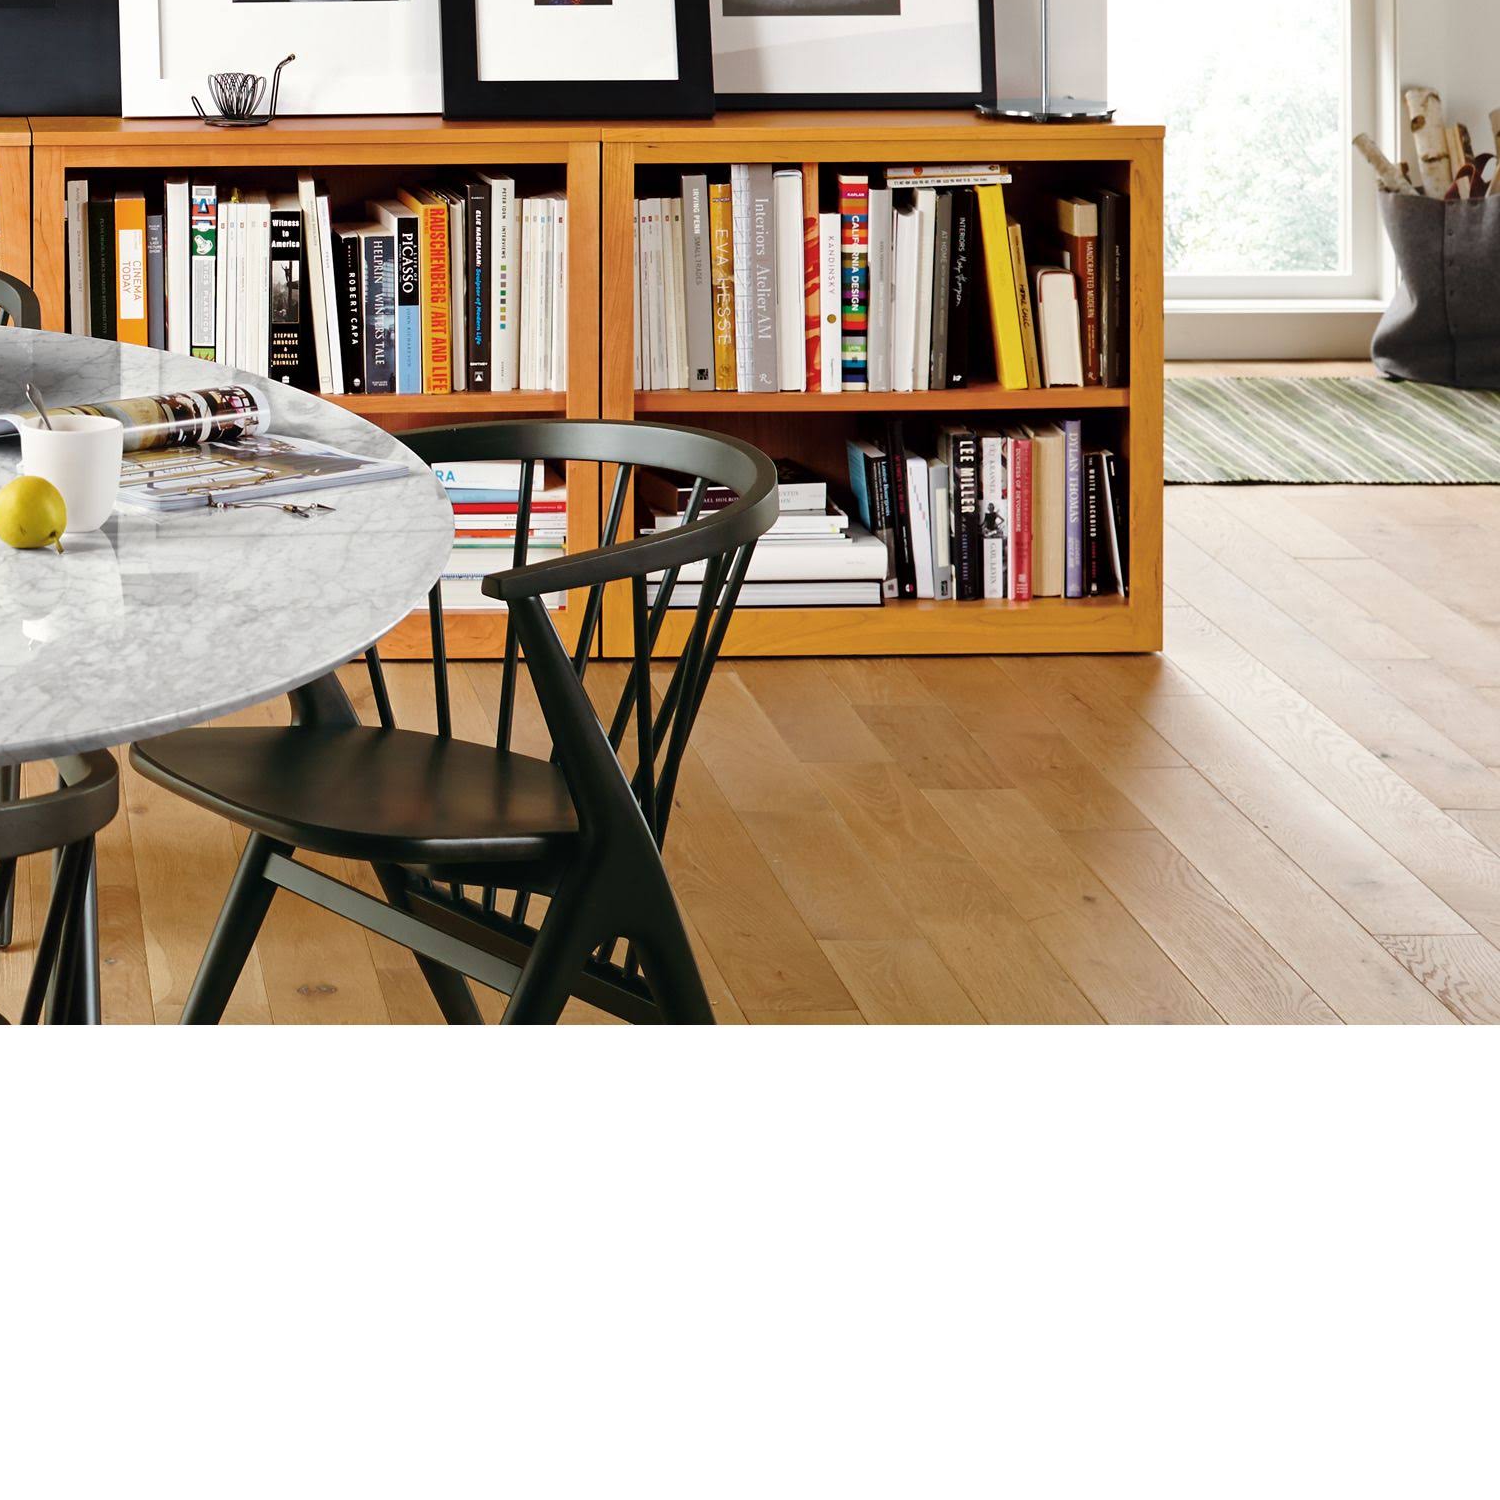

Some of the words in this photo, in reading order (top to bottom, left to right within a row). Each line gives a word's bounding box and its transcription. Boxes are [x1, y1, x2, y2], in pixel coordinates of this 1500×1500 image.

[272, 219, 300, 228] Witness
[693, 214, 701, 234] PENN
[755, 198, 770, 256] Interiors
[941, 230, 948, 239] AT
[271, 240, 300, 249] America
[429, 208, 446, 304] RAUSCHENBERG
[716, 229, 729, 266] EVA
[122, 261, 132, 293] TODAY
[373, 240, 384, 284] HELPRIN
[402, 232, 414, 293] PICASSO
[828, 235, 836, 295] KANDINSKY
[1085, 241, 1095, 288] HANDCRAFTED
[132, 260, 142, 301] CINEMA
[348, 272, 357, 312] ROBERT
[475, 268, 483, 296] Sculptor
[756, 264, 771, 311] Atelier
[852, 275, 861, 311] DESIGN
[717, 277, 732, 345] HESSE
[1086, 289, 1096, 318] MODERN
[351, 318, 359, 345] CAPA
[430, 311, 447, 335] ART
[475, 332, 483, 345] Life
[757, 312, 772, 340] AM
[375, 341, 385, 365] TALE
[431, 337, 447, 363] AND
[432, 366, 448, 391] LIFE
[959, 440, 974, 463] LEE
[1069, 433, 1079, 472] DYLAN
[960, 467, 975, 513] MILLER
[1015, 479, 1021, 488] OF
[1069, 475, 1079, 523] THOMAS
[1089, 495, 1097, 537] BLACKBIRD
